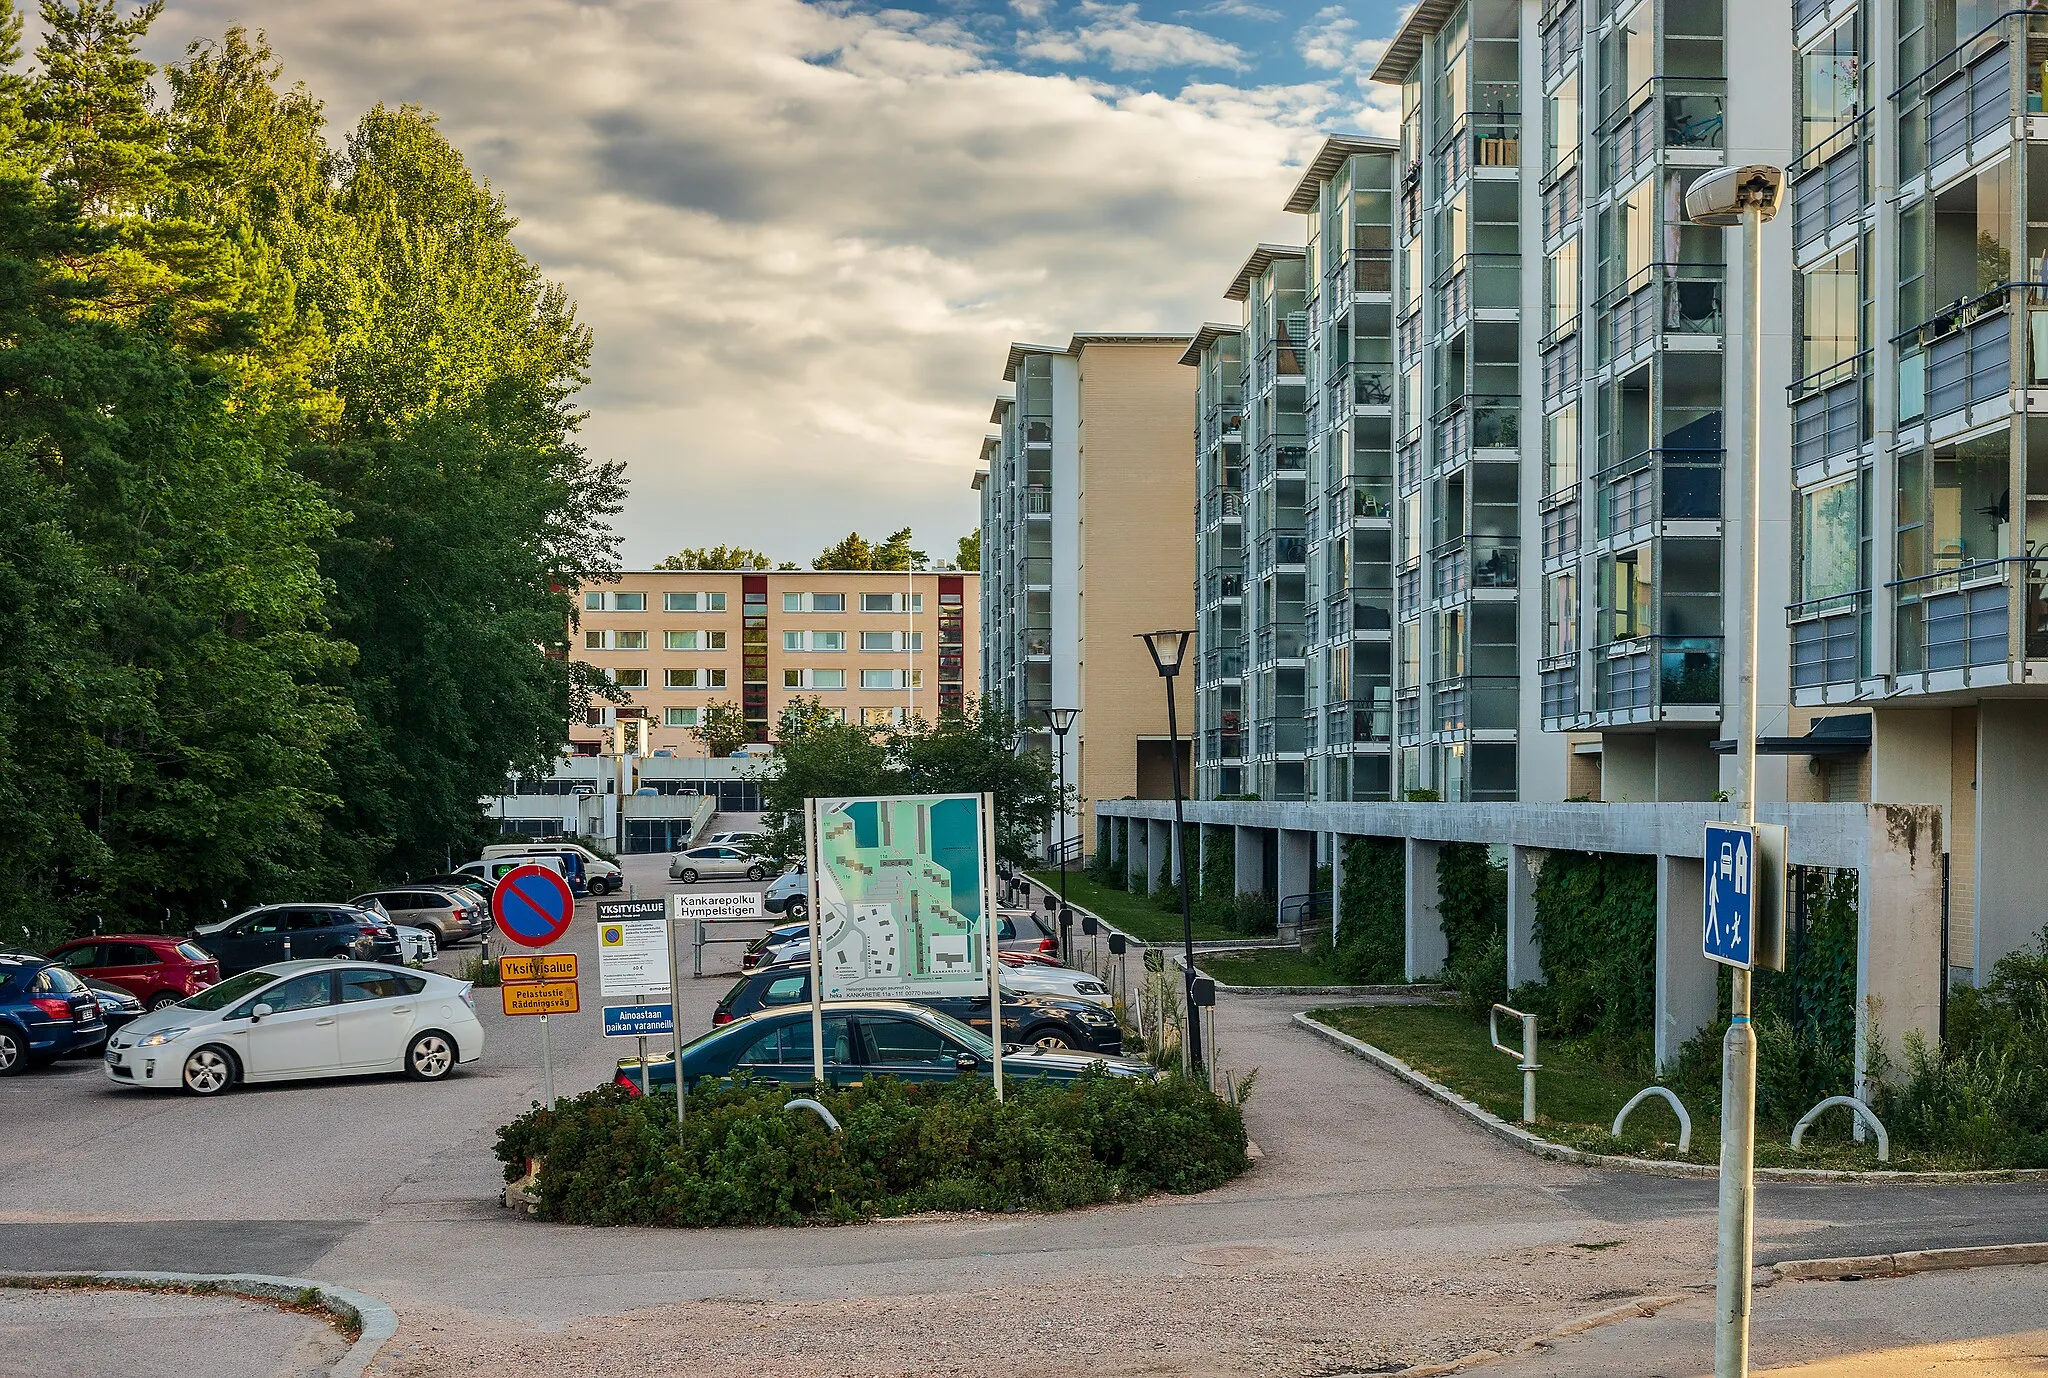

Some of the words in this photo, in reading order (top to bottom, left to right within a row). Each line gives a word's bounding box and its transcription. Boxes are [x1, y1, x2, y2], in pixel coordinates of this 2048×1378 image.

[680, 895, 755, 906] Kankarepolku
[600, 903, 663, 913] YKSITYISALUE
[682, 906, 755, 917] Hympelstigen
[506, 962, 572, 975] Yksityisalue
[517, 988, 563, 998] Pelastustie
[512, 999, 569, 1008] Räddningsväg
[620, 1011, 662, 1020] Ainoastaan
[606, 1022, 631, 1033] paikan
